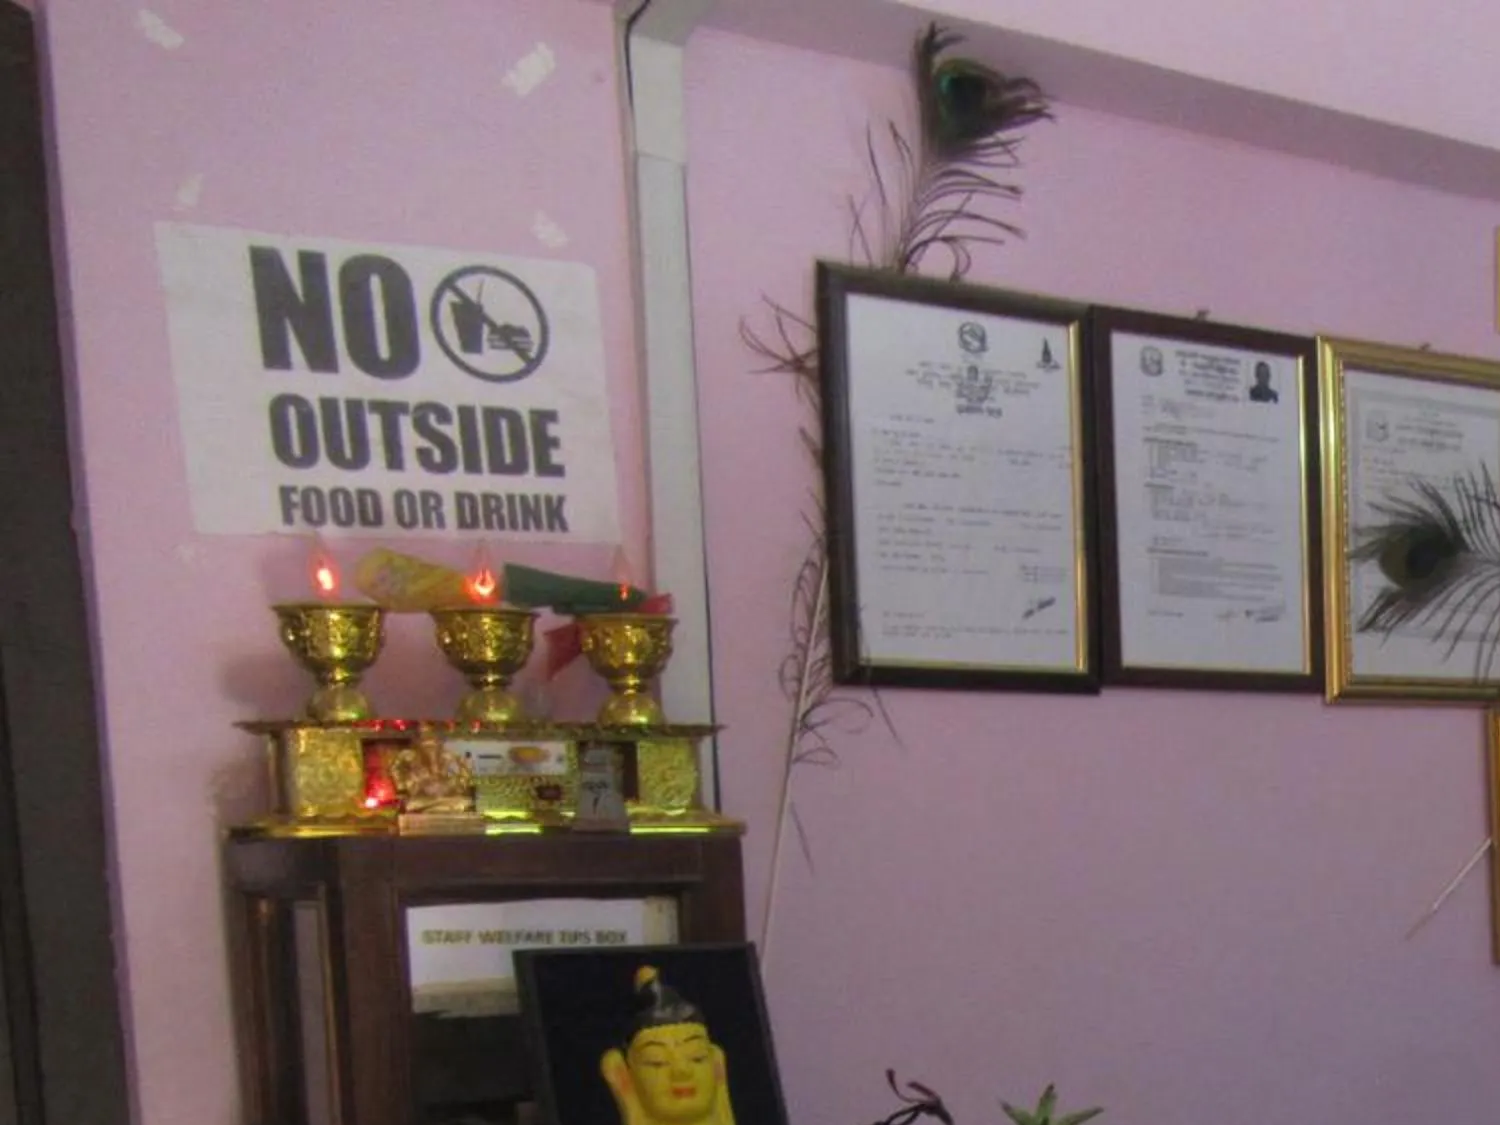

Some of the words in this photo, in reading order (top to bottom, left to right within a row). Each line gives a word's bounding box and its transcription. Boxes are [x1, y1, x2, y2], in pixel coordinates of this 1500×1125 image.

[249, 246, 421, 380] NO
[267, 393, 566, 478] OUTSIDE
[279, 485, 384, 529] FOOD
[394, 489, 446, 531] OR
[456, 491, 569, 533] DRINK
[421, 930, 471, 945] STAFF
[478, 930, 553, 945] WELFARE
[558, 930, 592, 945] TIPS
[594, 930, 628, 944] BOX
